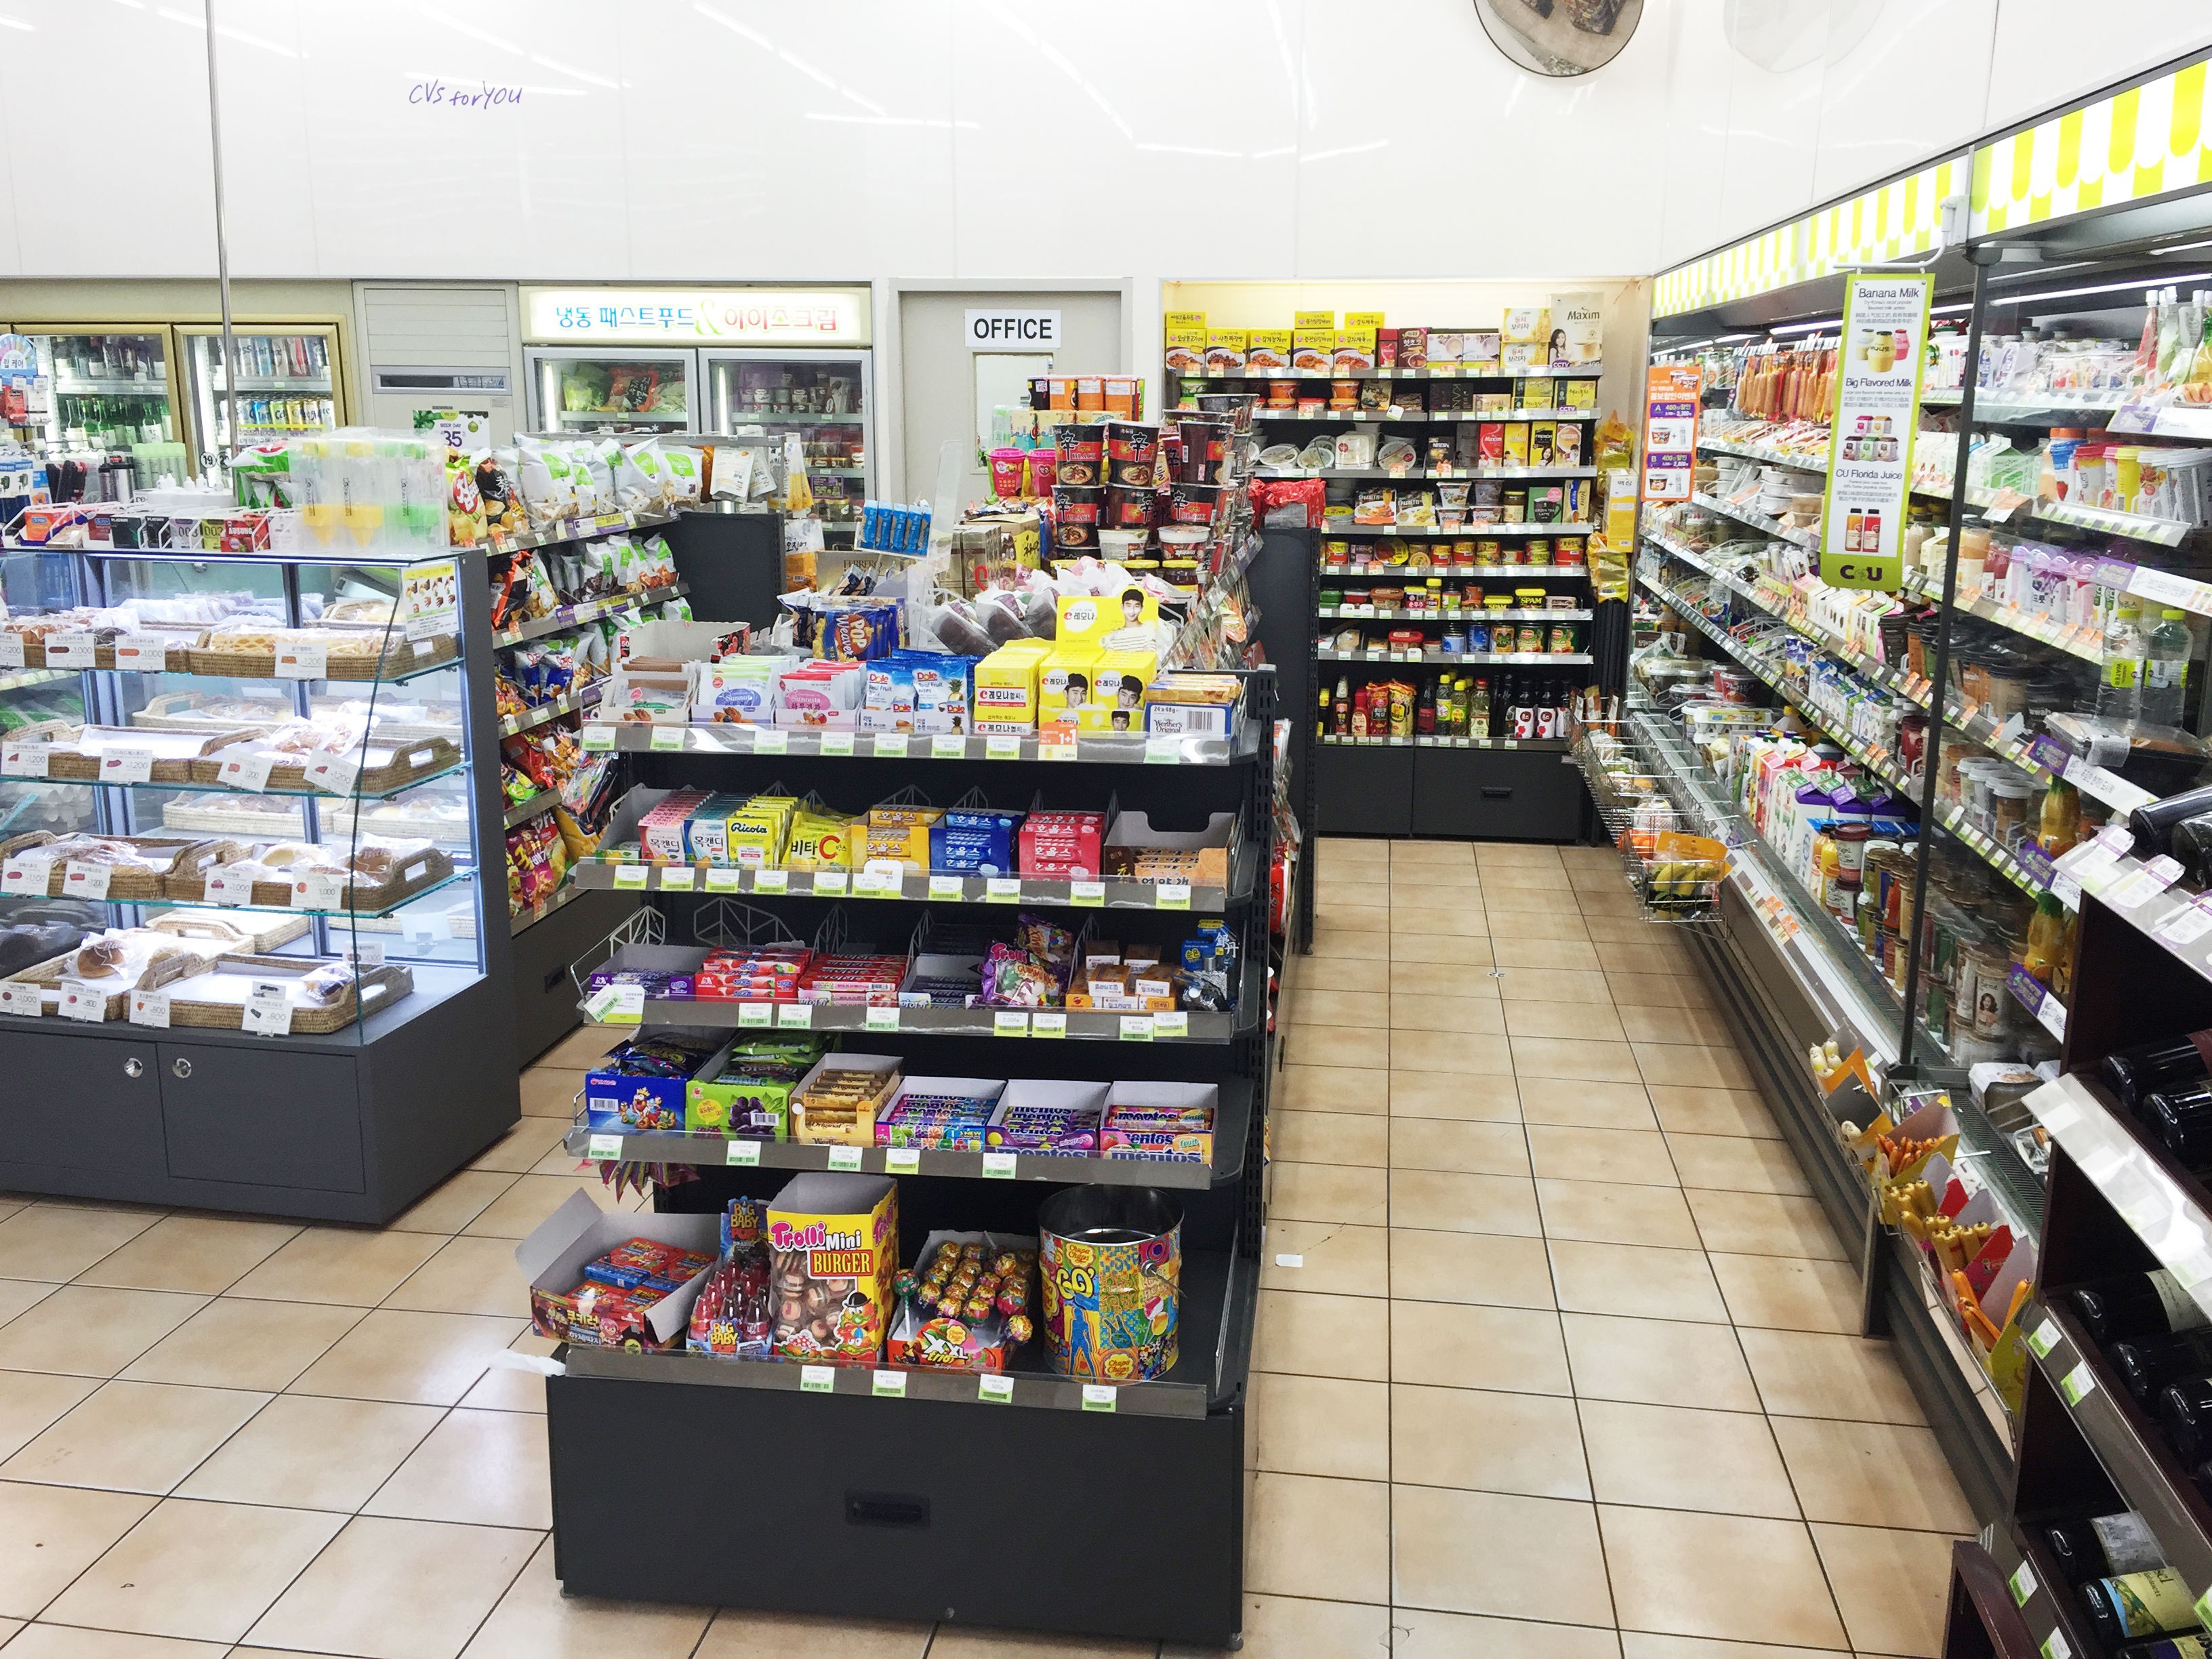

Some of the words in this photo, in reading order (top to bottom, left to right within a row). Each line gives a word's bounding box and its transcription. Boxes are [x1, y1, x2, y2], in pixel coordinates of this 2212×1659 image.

[1859, 288, 1896, 298] Banana
[1900, 288, 1919, 298] Milk
[556, 306, 591, 329] 냉동
[600, 306, 695, 329] 패스트푸드
[724, 307, 838, 331] 아이스크림
[1568, 310, 1600, 321] Maxim
[974, 319, 1052, 339] OFFICE
[1846, 378, 1858, 388] Big
[1860, 378, 1894, 387] Flavored
[1897, 379, 1912, 387] Milk
[1061, 430, 1079, 462] 辛
[1129, 432, 1150, 462] 辛
[203, 455, 213, 465] 19
[1836, 469, 1849, 477] CU
[1851, 470, 1878, 478] Florida
[1880, 470, 1902, 480] Juice
[1057, 493, 1074, 523] 辛
[1173, 490, 1189, 520] 辛
[1520, 597, 1542, 605] SPAM
[836, 615, 853, 655] Weaver
[851, 619, 867, 648] POP
[869, 674, 888, 682] Dole
[917, 672, 937, 680] Dole
[1154, 719, 1183, 727] Werther's
[1059, 729, 1076, 745] 1+1
[878, 812, 916, 821] 호올스
[954, 815, 991, 825] 호올스
[731, 822, 767, 834] Ricola
[1036, 825, 1074, 835] 호올스
[650, 838, 679, 848] 목캔디
[693, 835, 724, 847] 목캔디
[946, 846, 981, 856] 호올스
[1036, 846, 1071, 857] 호올스
[991, 943, 1027, 964] Trolli
[1011, 1112, 1070, 1121] mentos
[1119, 1111, 1177, 1120] mentos
[1179, 1139, 1200, 1148] fruit
[1110, 1151, 1203, 1164] mentos
[734, 1201, 755, 1215] BIG
[731, 1214, 759, 1229] BABY
[769, 1221, 828, 1251] Trolli
[825, 1229, 862, 1251] Mini
[1069, 1244, 1089, 1254] Chupa
[1068, 1251, 1090, 1262] Chups
[813, 1252, 870, 1274] BURGER
[567, 1309, 599, 1326] 쿠키런
[713, 1319, 734, 1333] BIG
[710, 1332, 739, 1345] BABY
[923, 1332, 968, 1359] XXL
[1107, 1366, 1130, 1376] Chups
